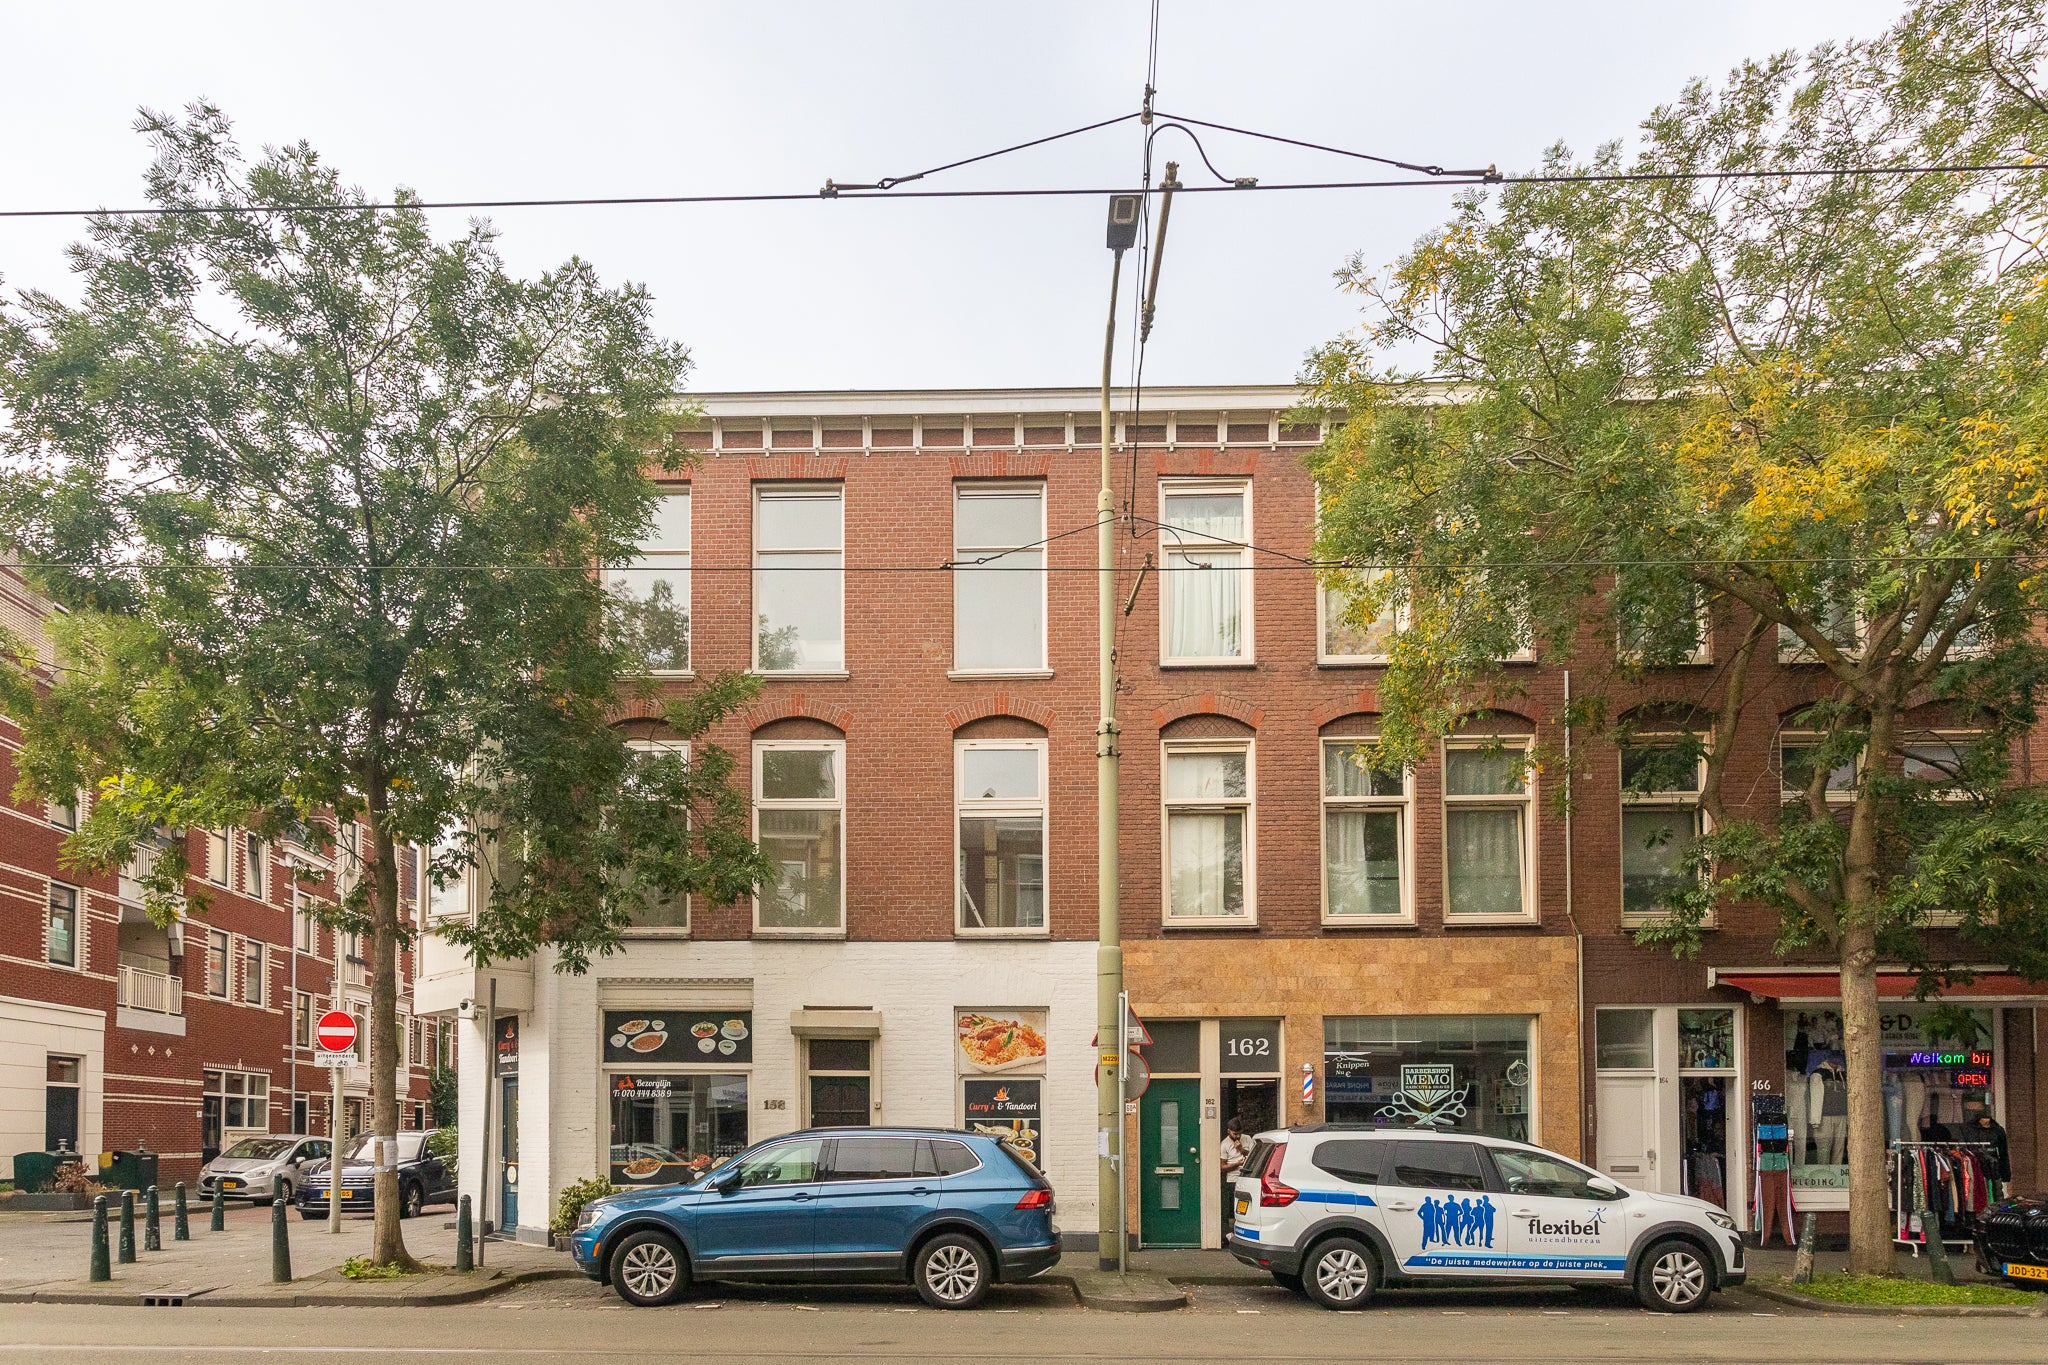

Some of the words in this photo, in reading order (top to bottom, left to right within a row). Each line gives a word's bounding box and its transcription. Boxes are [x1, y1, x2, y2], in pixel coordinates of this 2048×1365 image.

[1228, 1038, 1270, 1056] 162
[1910, 1053, 1965, 1064] Welkom
[1972, 1053, 1990, 1066] bij
[1336, 1062, 1370, 1070] Knippen
[636, 1079, 672, 1090] Bezorglijn
[1405, 1074, 1450, 1085] MEMO
[1957, 1074, 1987, 1085] OPEN
[1751, 1080, 1771, 1091] 166
[621, 1089, 636, 1098] 070
[764, 1099, 786, 1110] 158
[997, 1101, 1004, 1111] &
[1005, 1102, 1037, 1111] Tandoori
[1792, 1178, 1834, 1186] KLEDING
[1528, 1219, 1601, 1236] flexibel
[1445, 1258, 1470, 1267] juiste
[1473, 1259, 1526, 1267] medewerker
[1542, 1259, 1554, 1267] de
[1555, 1260, 1582, 1268] juiste
